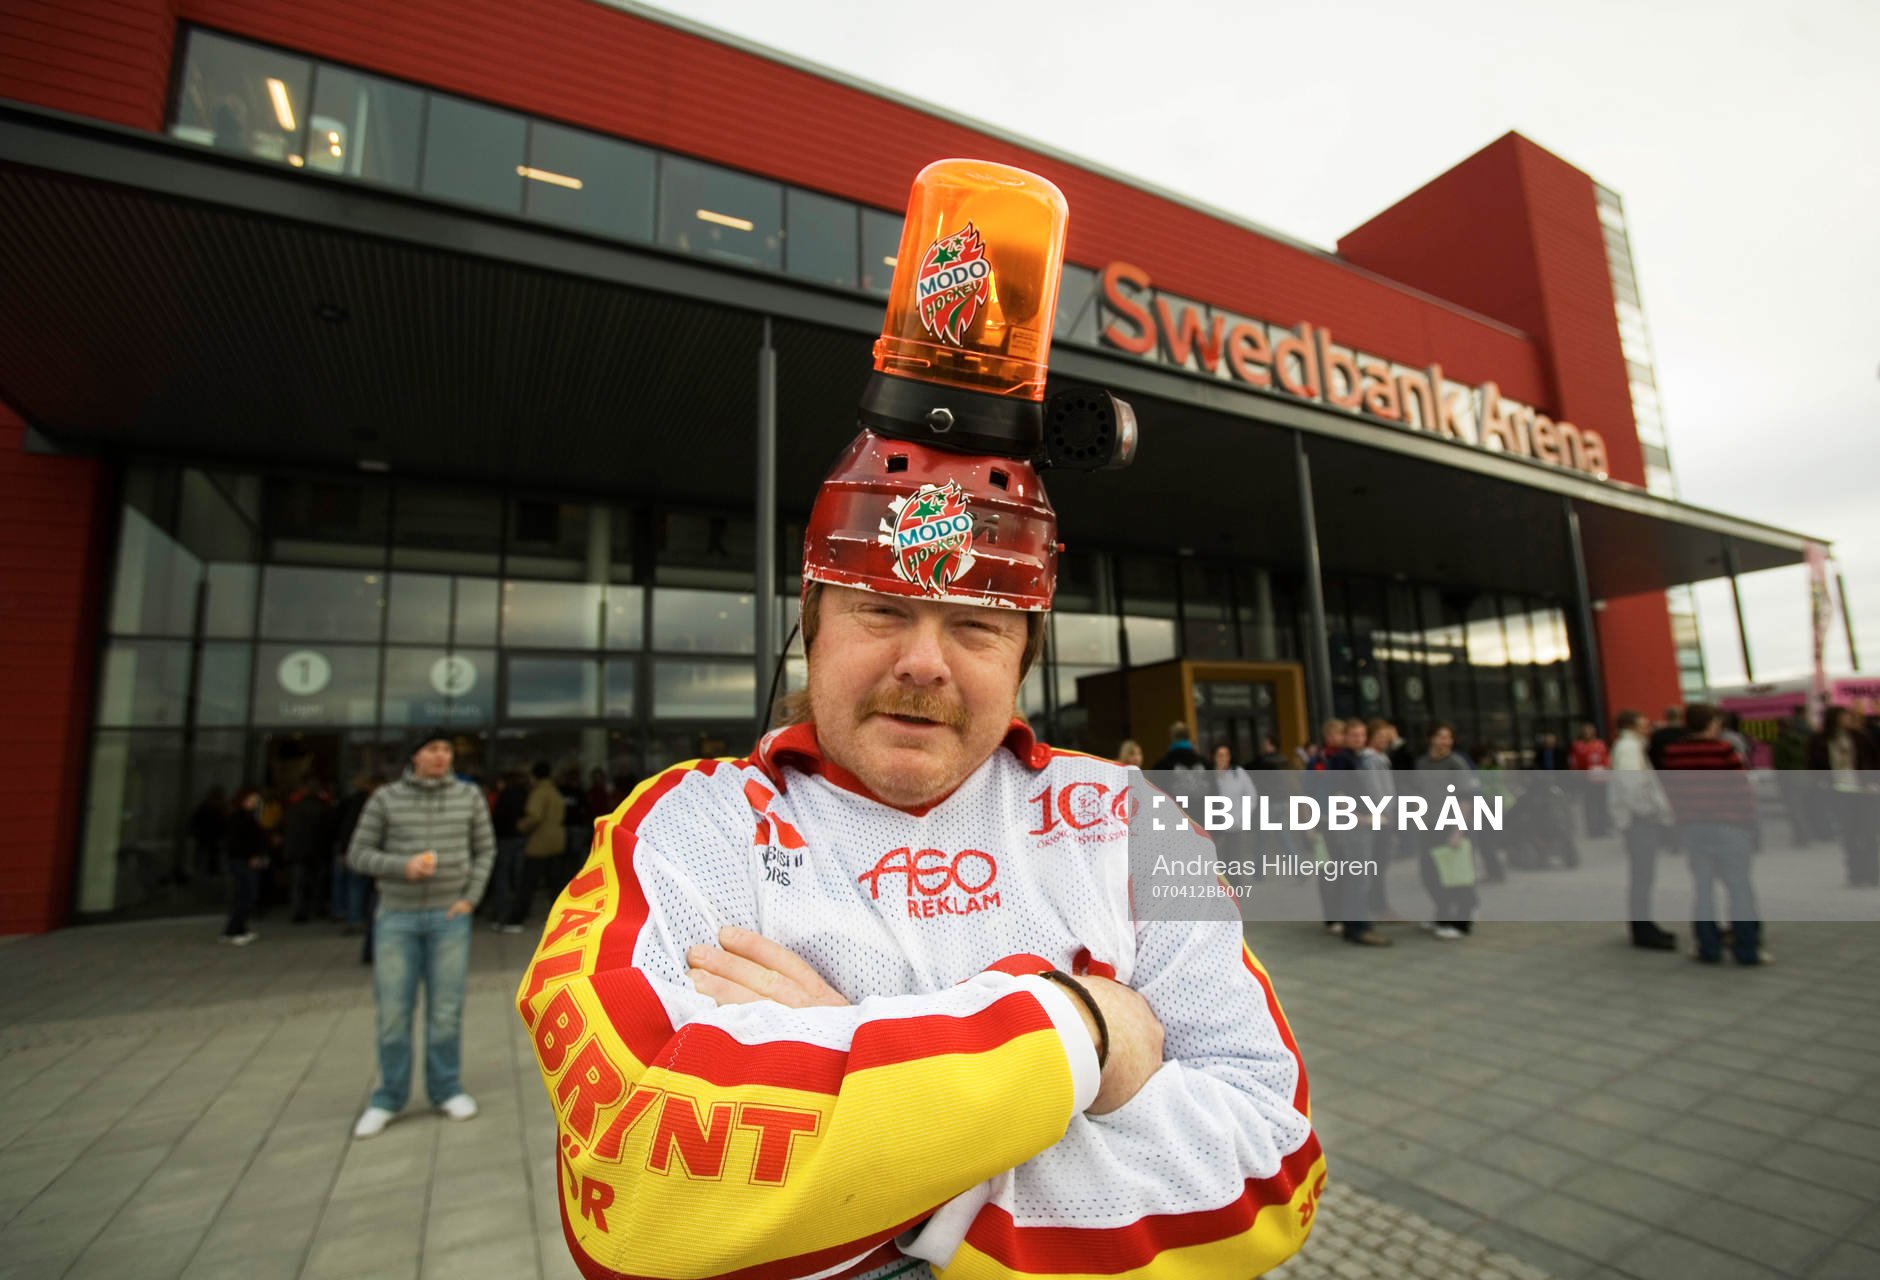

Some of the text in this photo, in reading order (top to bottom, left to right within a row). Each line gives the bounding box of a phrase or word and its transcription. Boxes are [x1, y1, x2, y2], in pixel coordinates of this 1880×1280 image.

[920, 261, 986, 298] MODO
[926, 281, 981, 319] HOCKEY
[1101, 261, 1609, 471] Swedbank Arena
[897, 515, 970, 547] MODO
[907, 534, 965, 571] HOCKEY
[907, 891, 1001, 920] REKLAM
